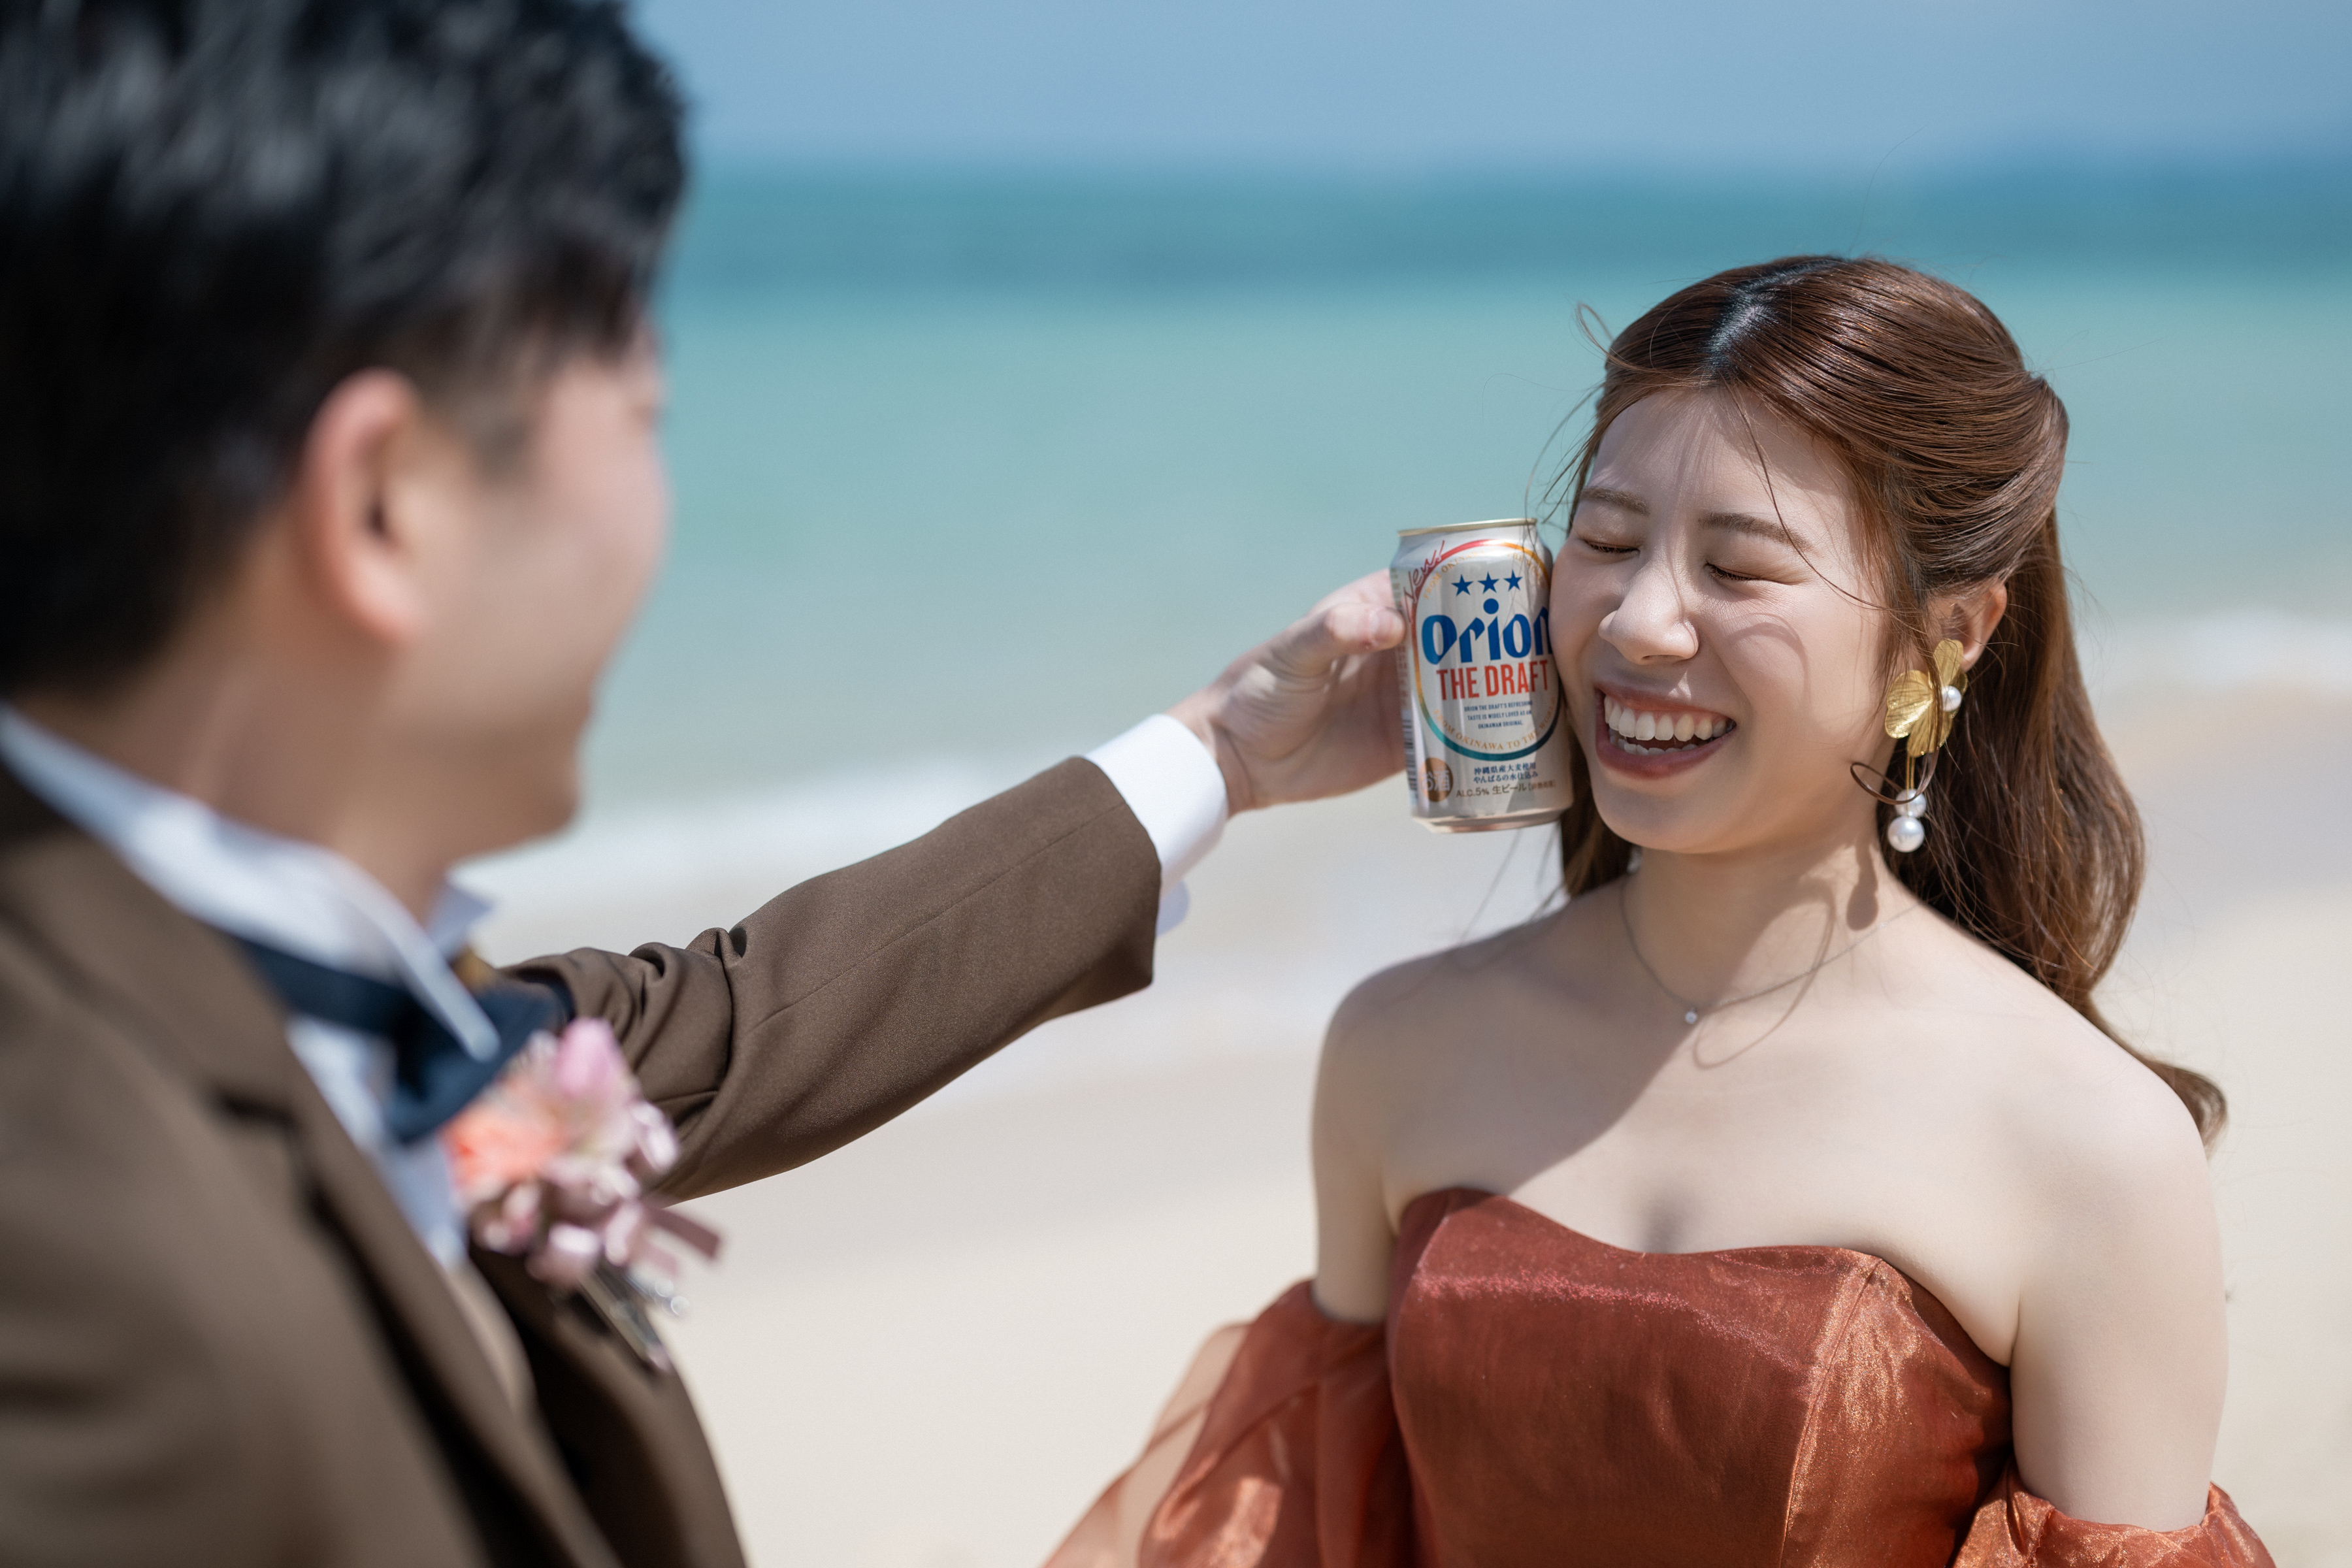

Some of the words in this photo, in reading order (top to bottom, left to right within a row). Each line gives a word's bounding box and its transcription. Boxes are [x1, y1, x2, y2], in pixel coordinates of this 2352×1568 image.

[1403, 540, 1445, 623] New!
[1424, 572, 1442, 600] FROM
[1422, 598, 1554, 665] Orion
[1436, 667, 1479, 700] THE
[1484, 660, 1548, 697] DRAFT
[1433, 708, 1455, 735] FROM
[1456, 732, 1504, 750] OKINAWA
[1507, 741, 1520, 749] TO
[1522, 728, 1539, 744] THE
